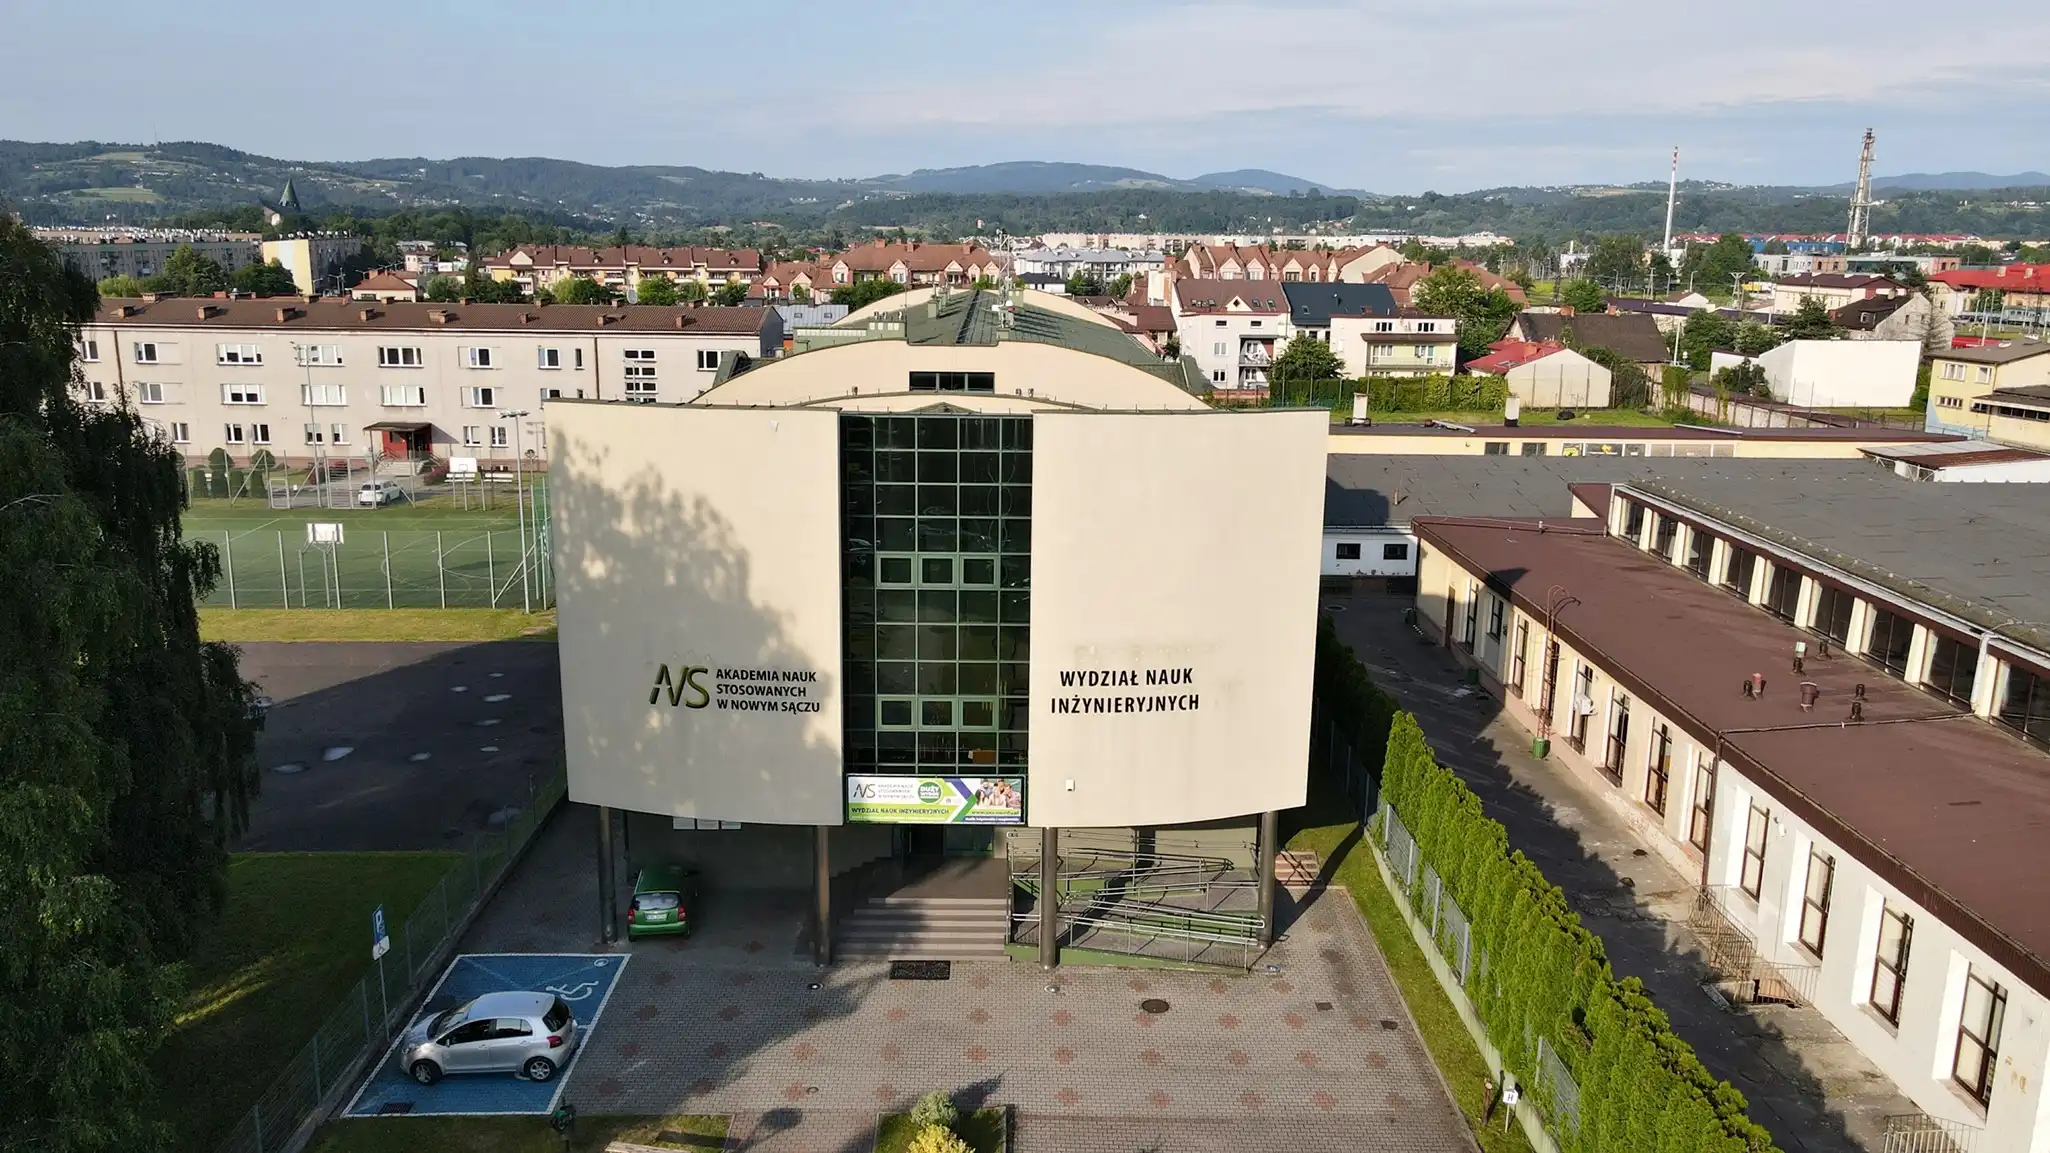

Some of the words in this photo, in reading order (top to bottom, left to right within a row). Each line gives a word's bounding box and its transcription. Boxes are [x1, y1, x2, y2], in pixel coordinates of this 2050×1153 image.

[716, 668, 780, 682] AKADEMIA
[782, 671, 817, 682] NAUK
[1060, 670, 1139, 687] WYDZIAŁ
[1146, 667, 1193, 685] NAUK
[716, 683, 807, 697] STOSOWANYCH
[717, 699, 728, 709] W
[731, 699, 778, 712] NOWYM
[781, 702, 820, 715] SĄCZU
[1051, 694, 1199, 713] INŻYNIERYJNYCH
[375, 909, 382, 933] P
